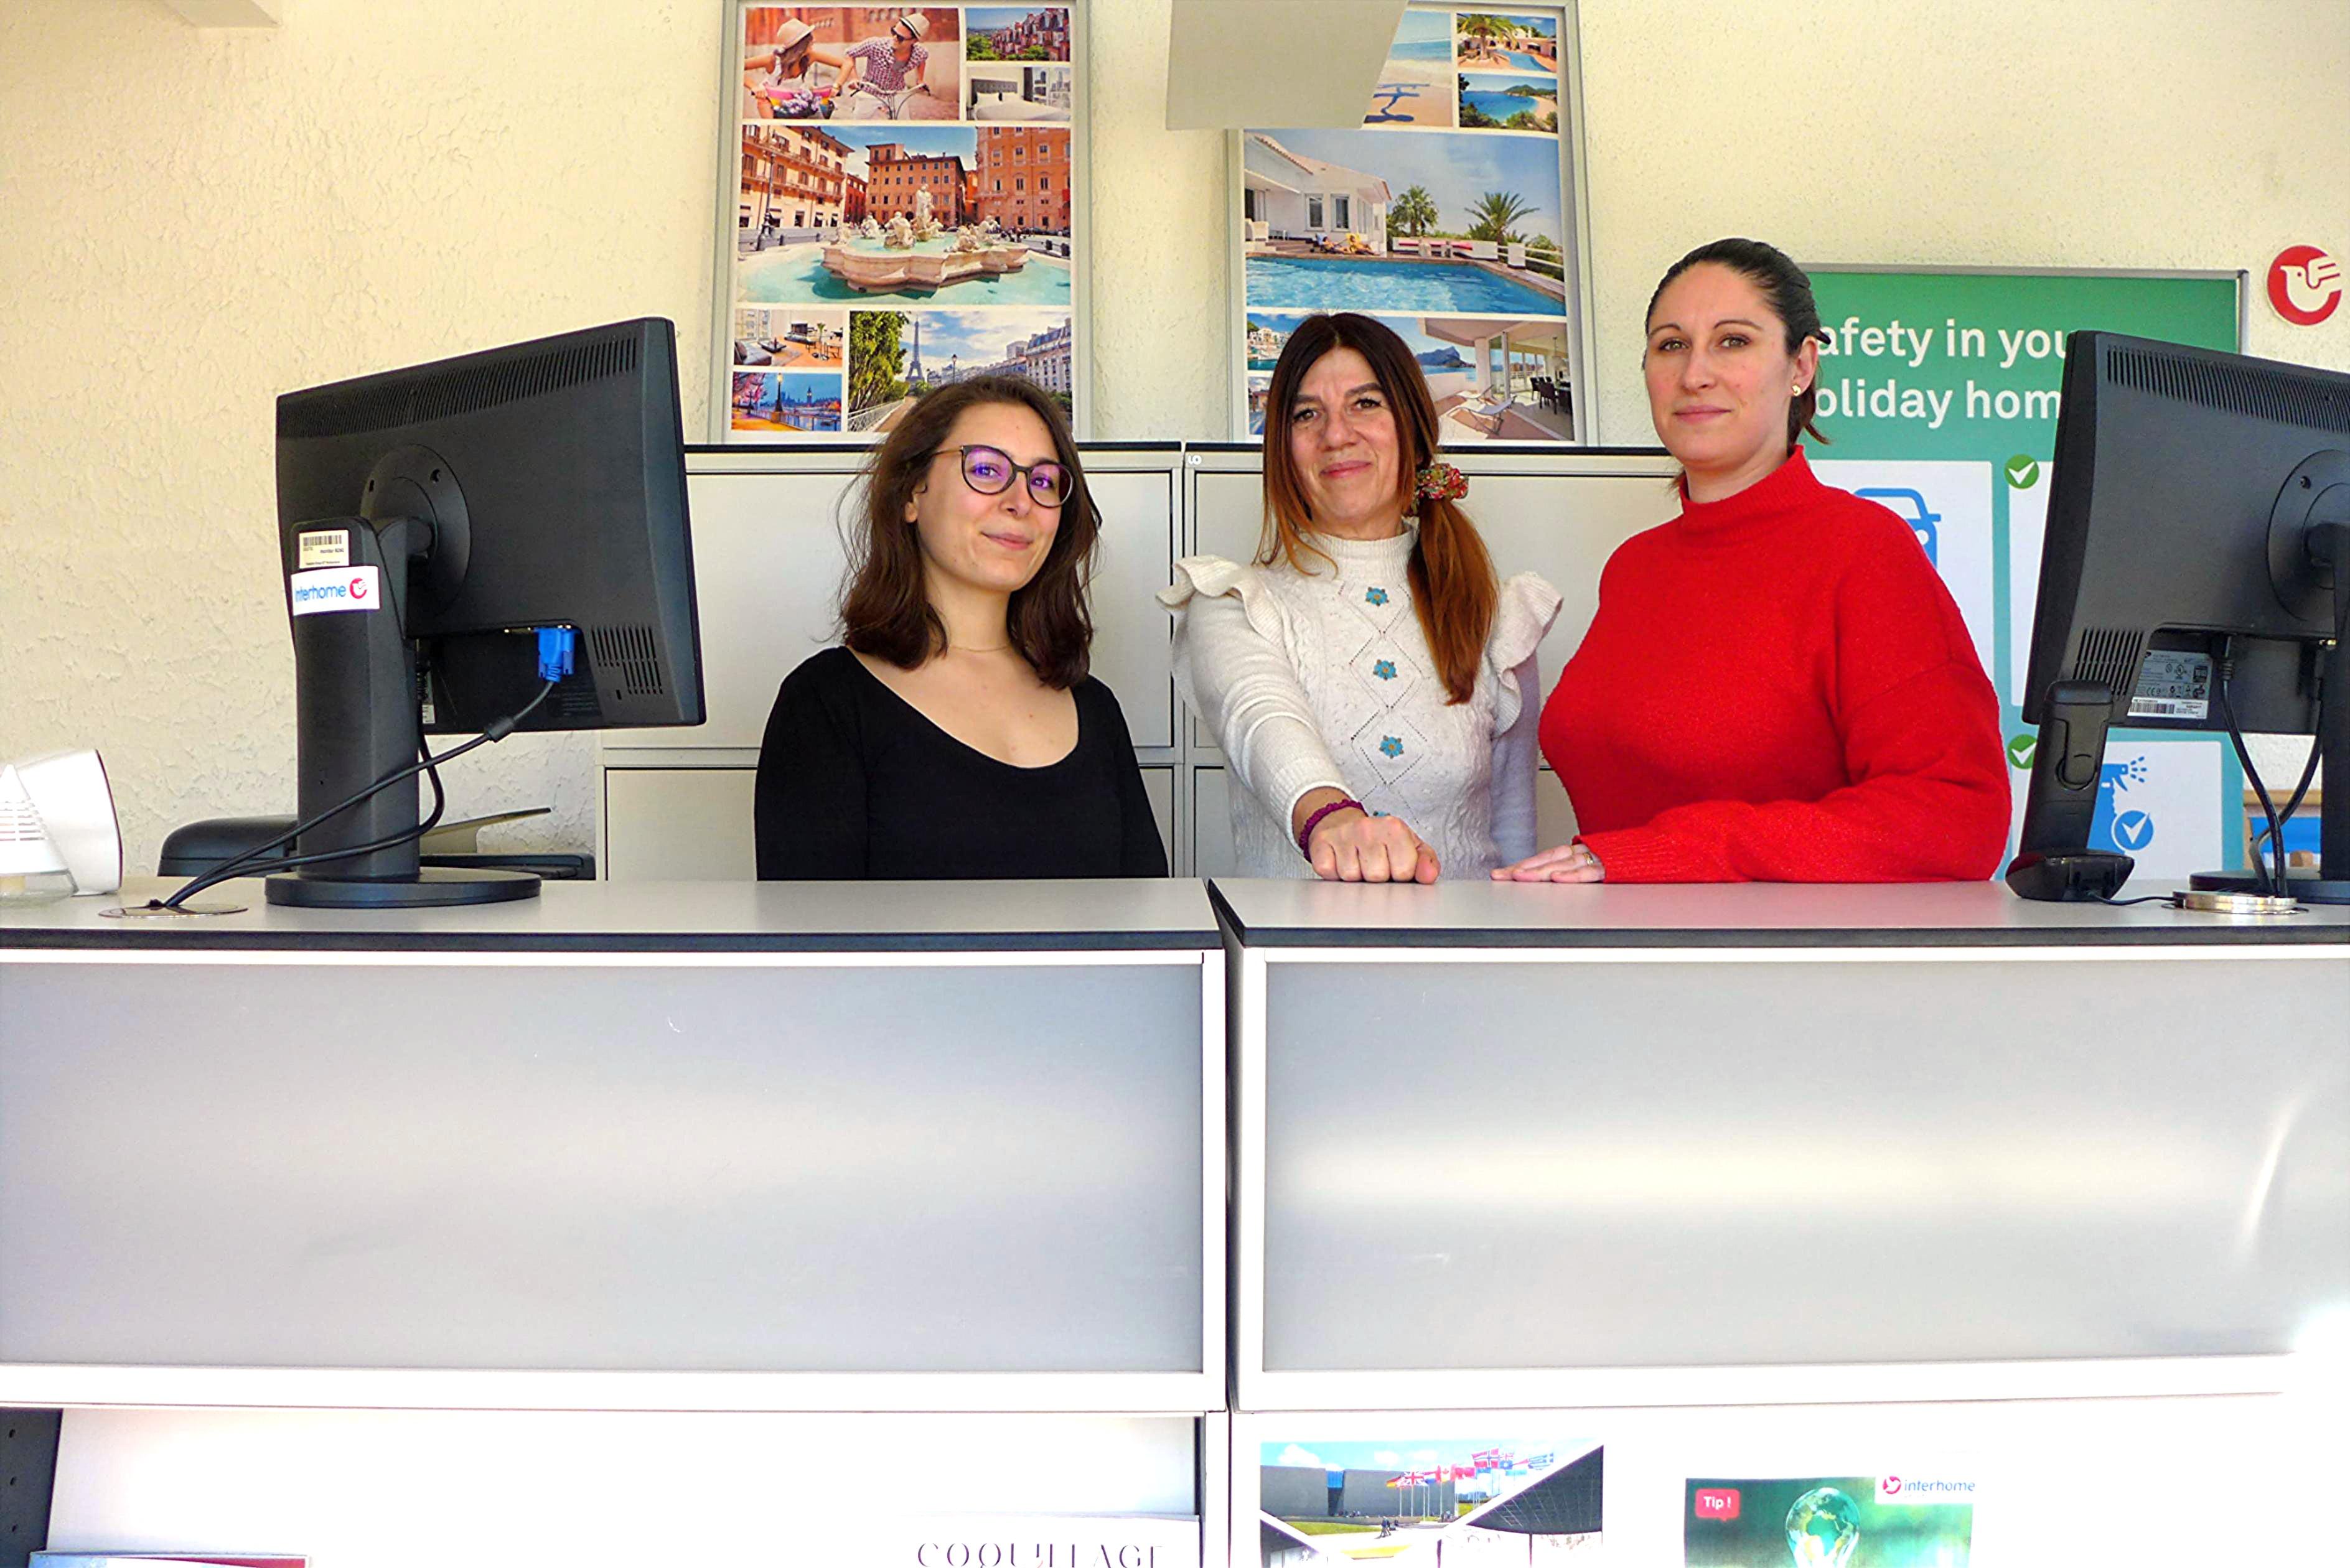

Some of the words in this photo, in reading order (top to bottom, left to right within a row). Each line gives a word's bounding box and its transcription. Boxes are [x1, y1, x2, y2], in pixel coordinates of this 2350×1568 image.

[1817, 316, 1933, 368] afety
[1946, 318, 1985, 357] in
[1998, 329, 2067, 368] you
[1815, 378, 1953, 429] oliday
[1966, 380, 2061, 419] hom
[1904, 1479, 1975, 1491] interhome
[1703, 1496, 1725, 1510] Tip
